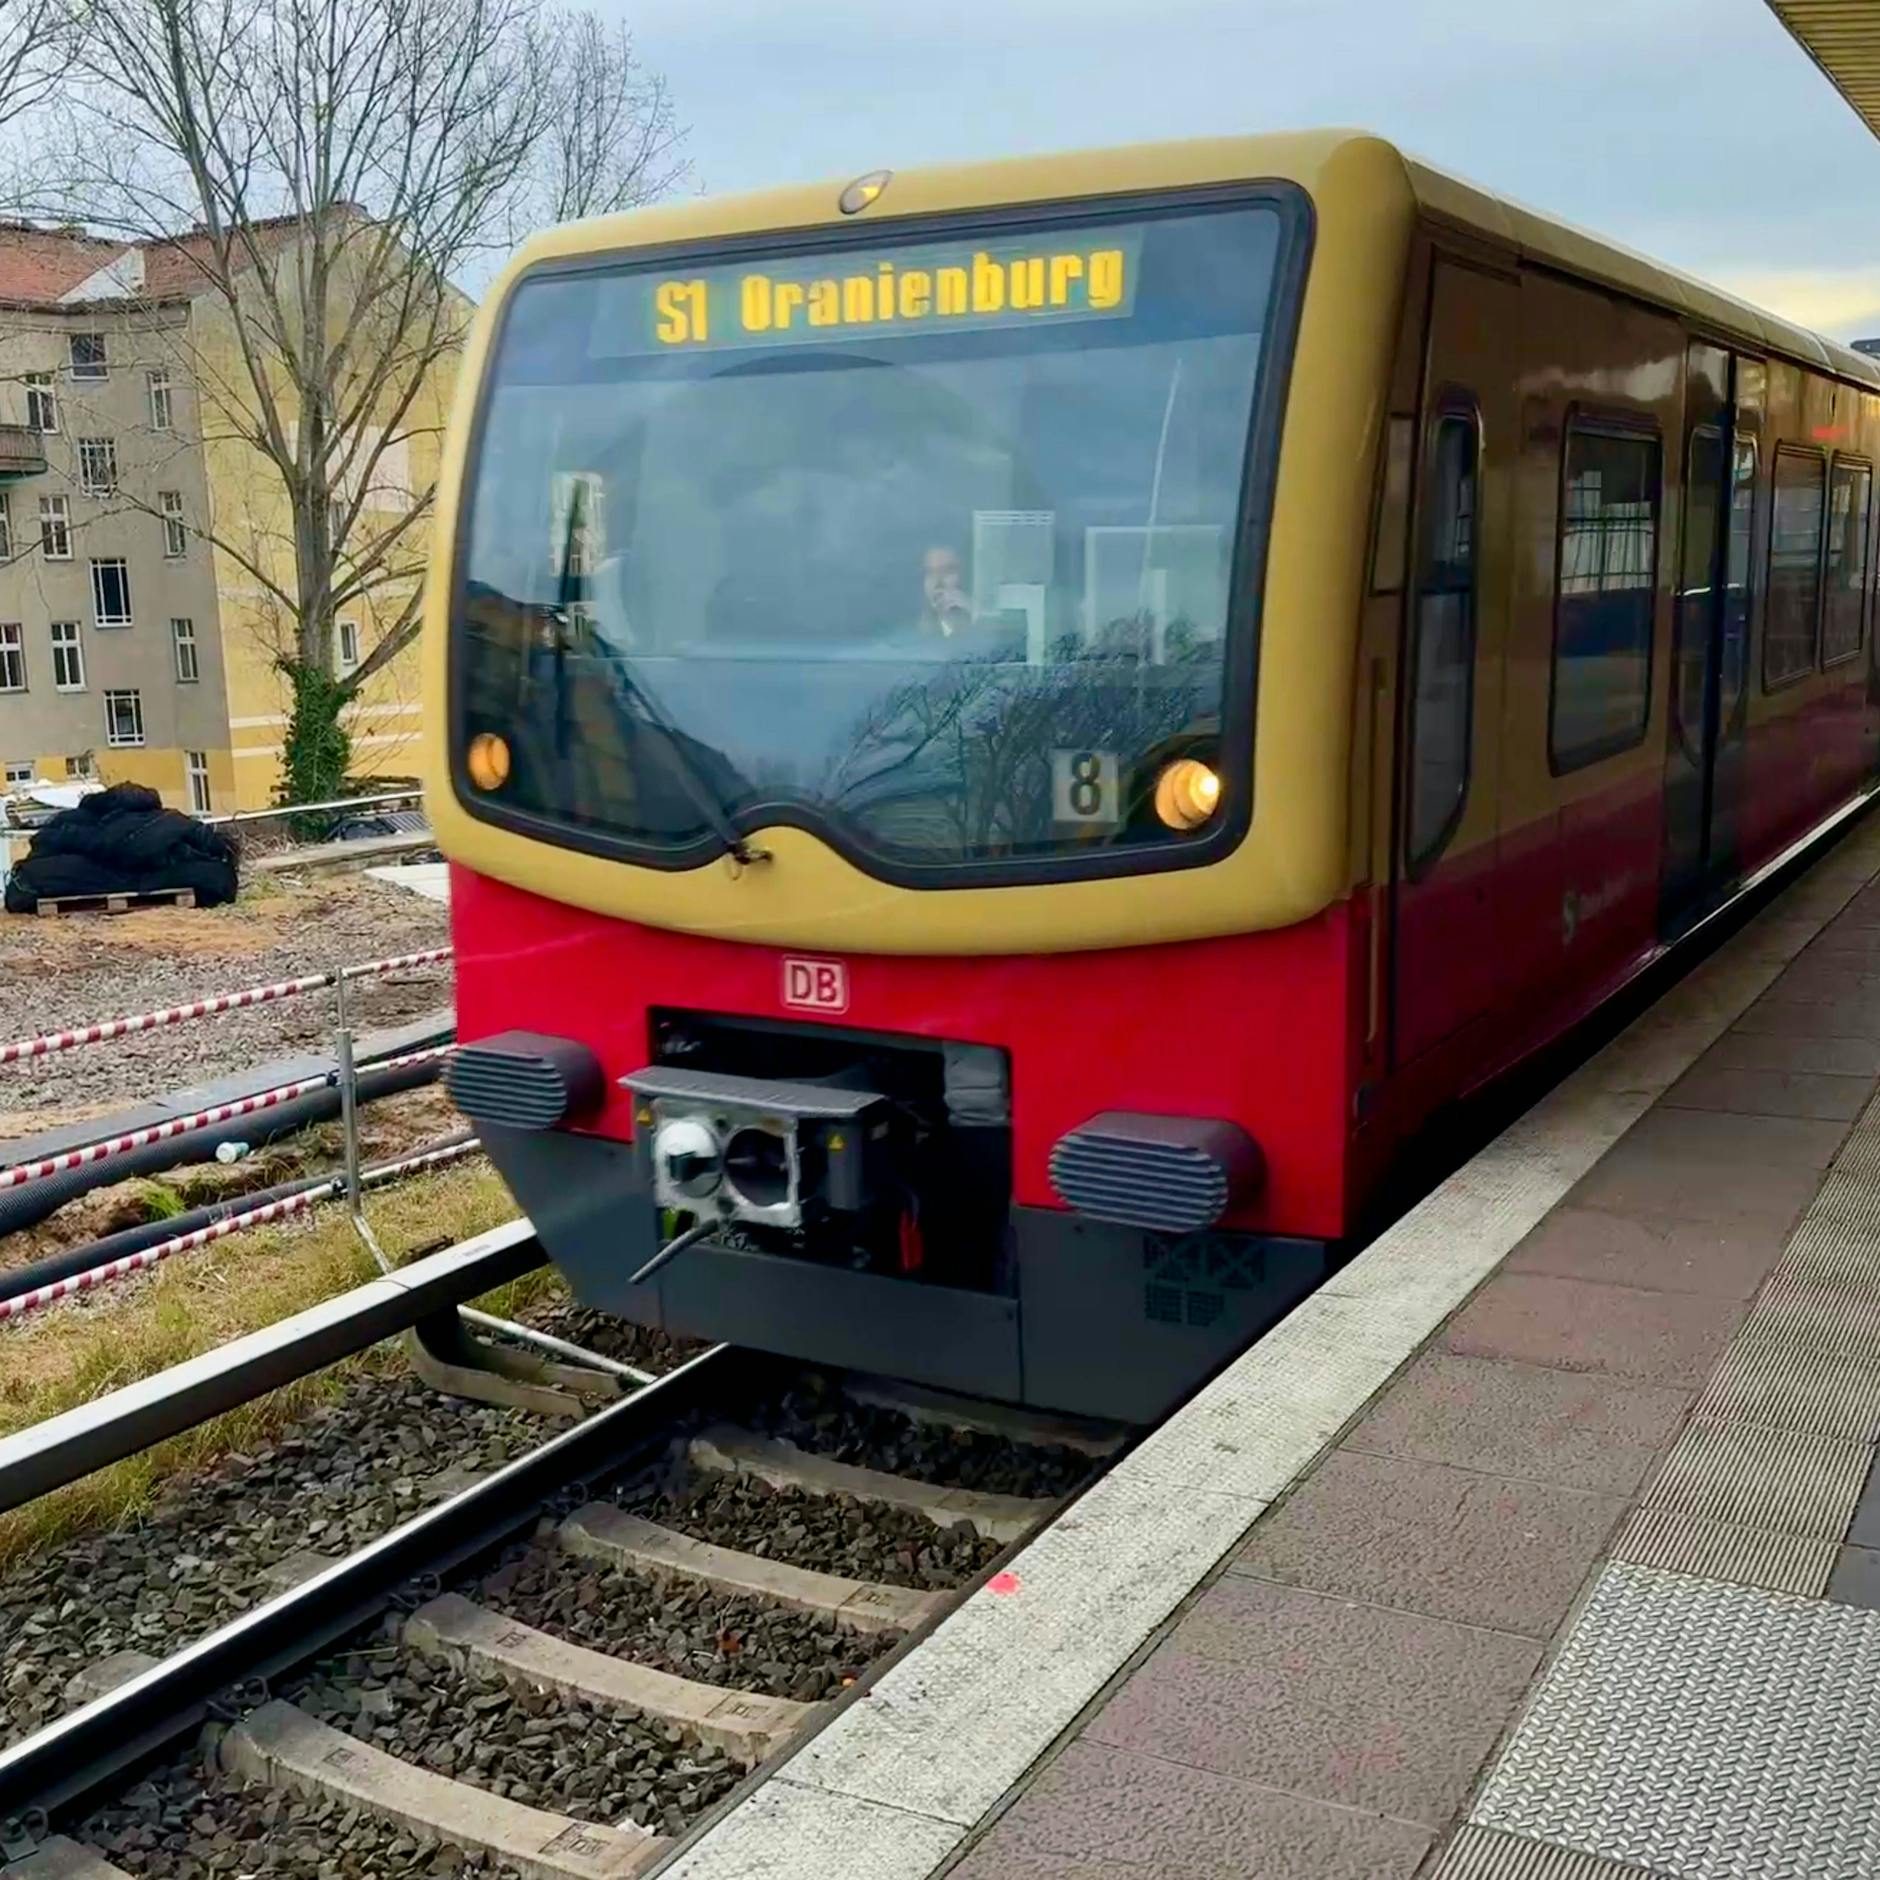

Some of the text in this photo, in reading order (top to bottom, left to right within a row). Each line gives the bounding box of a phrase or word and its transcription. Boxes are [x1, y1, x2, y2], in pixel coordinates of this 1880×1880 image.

[656, 249, 1124, 343] S1 Oranienburg
[1070, 752, 1100, 816] 8
[791, 963, 837, 1004] DB
